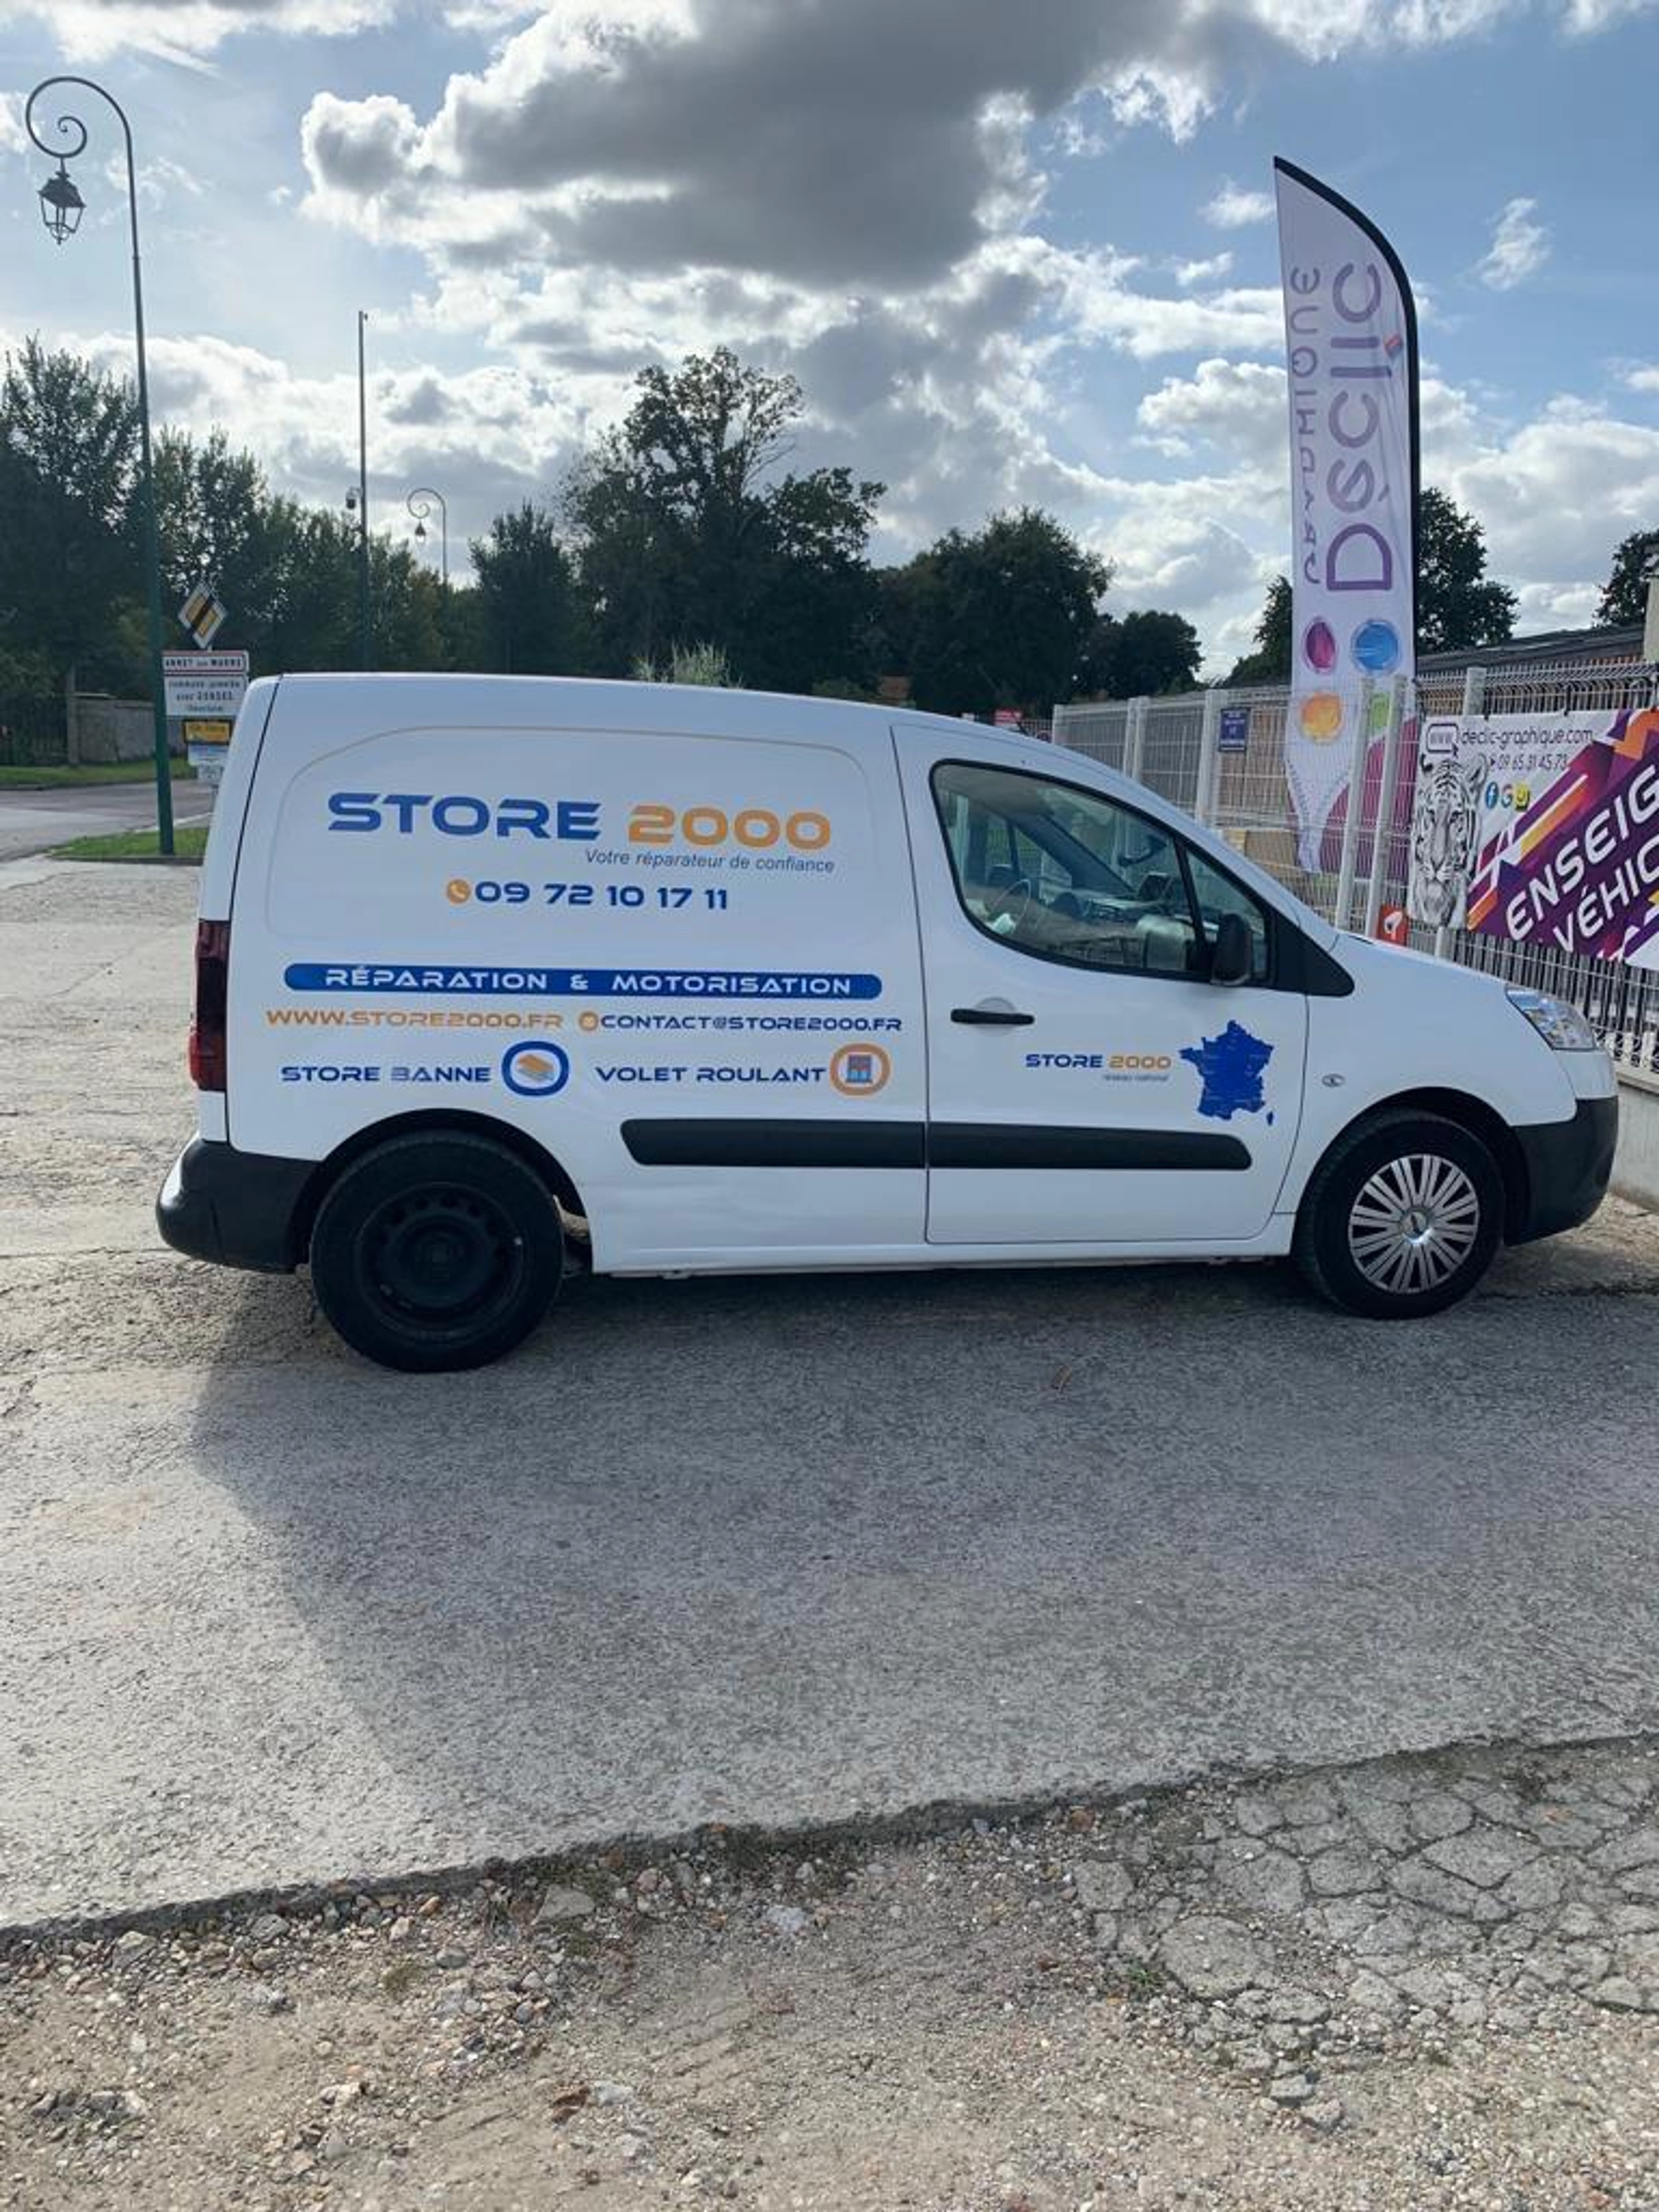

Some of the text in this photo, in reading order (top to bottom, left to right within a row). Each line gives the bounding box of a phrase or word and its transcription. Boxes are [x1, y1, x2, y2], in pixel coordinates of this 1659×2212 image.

[1461, 727, 1593, 750] declic-graphique.com
[328, 792, 831, 849] STORE 2000
[586, 849, 835, 873] Votre réparateur de confiance
[1506, 765, 1659, 941] ENSEIG
[475, 881, 727, 909] 09 72 10 17 11
[325, 966, 851, 995] RÉPARATION & MOTORISATION
[267, 1010, 563, 1029] WWW.STORE2000.FR
[600, 1015, 902, 1032] CONTACT@STORE2000.FR
[1025, 1053, 1172, 1070] STORE 2000
[281, 1067, 491, 1082] STORE BANNE
[595, 1067, 826, 1082] VOLET ROULANT
